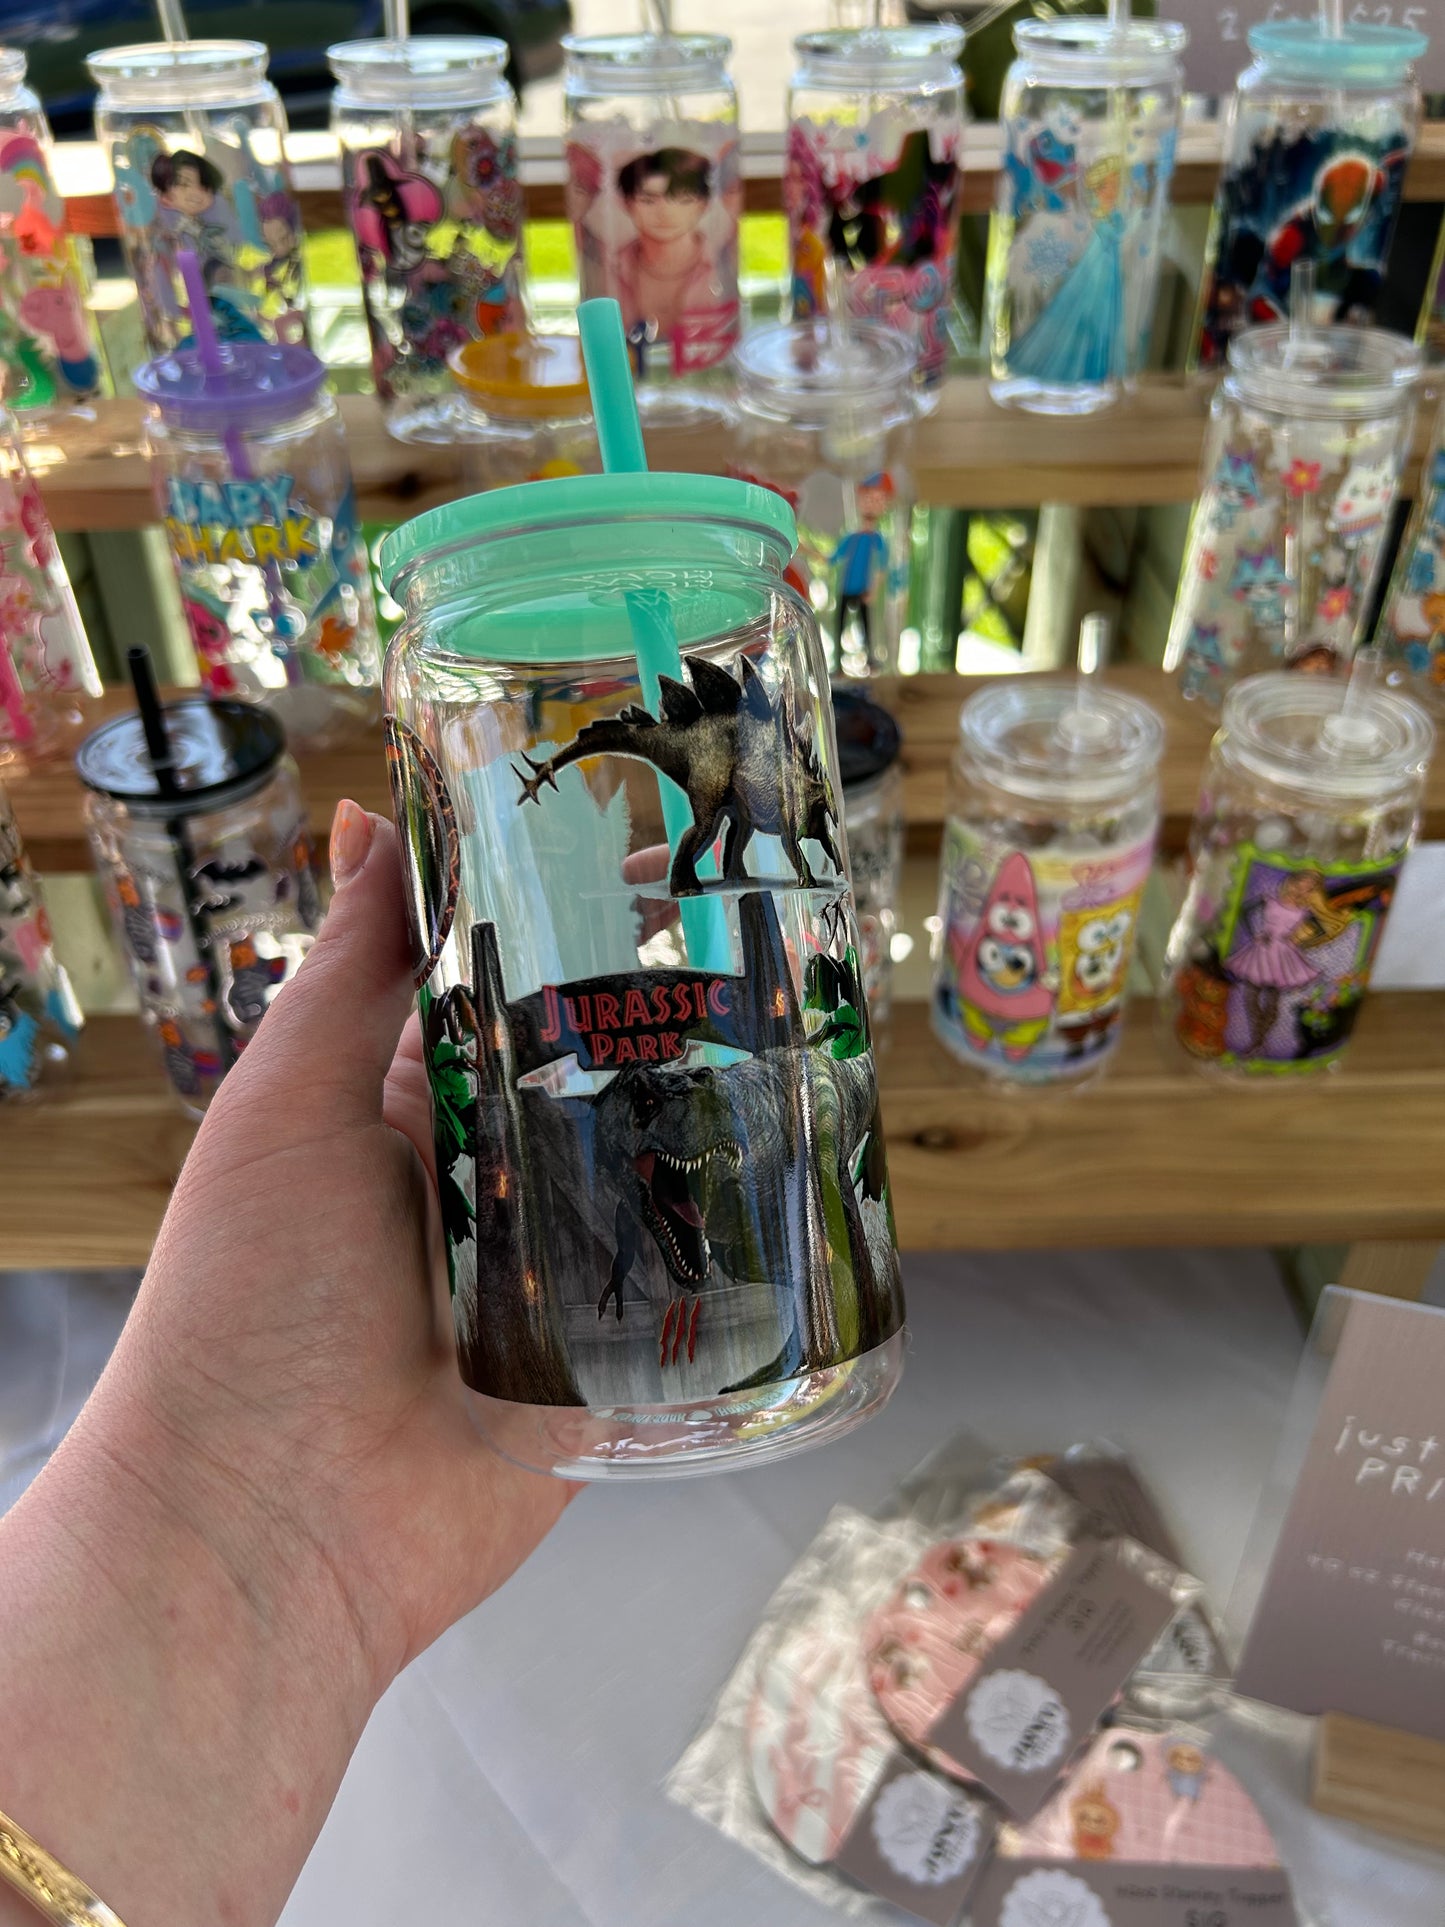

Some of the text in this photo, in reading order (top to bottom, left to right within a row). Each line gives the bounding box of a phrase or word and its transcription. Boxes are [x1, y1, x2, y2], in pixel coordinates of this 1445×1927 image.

[540, 979, 731, 1043] JURASSIC
[590, 1032, 684, 1066] PARK
[1334, 1415, 1439, 1463] just
